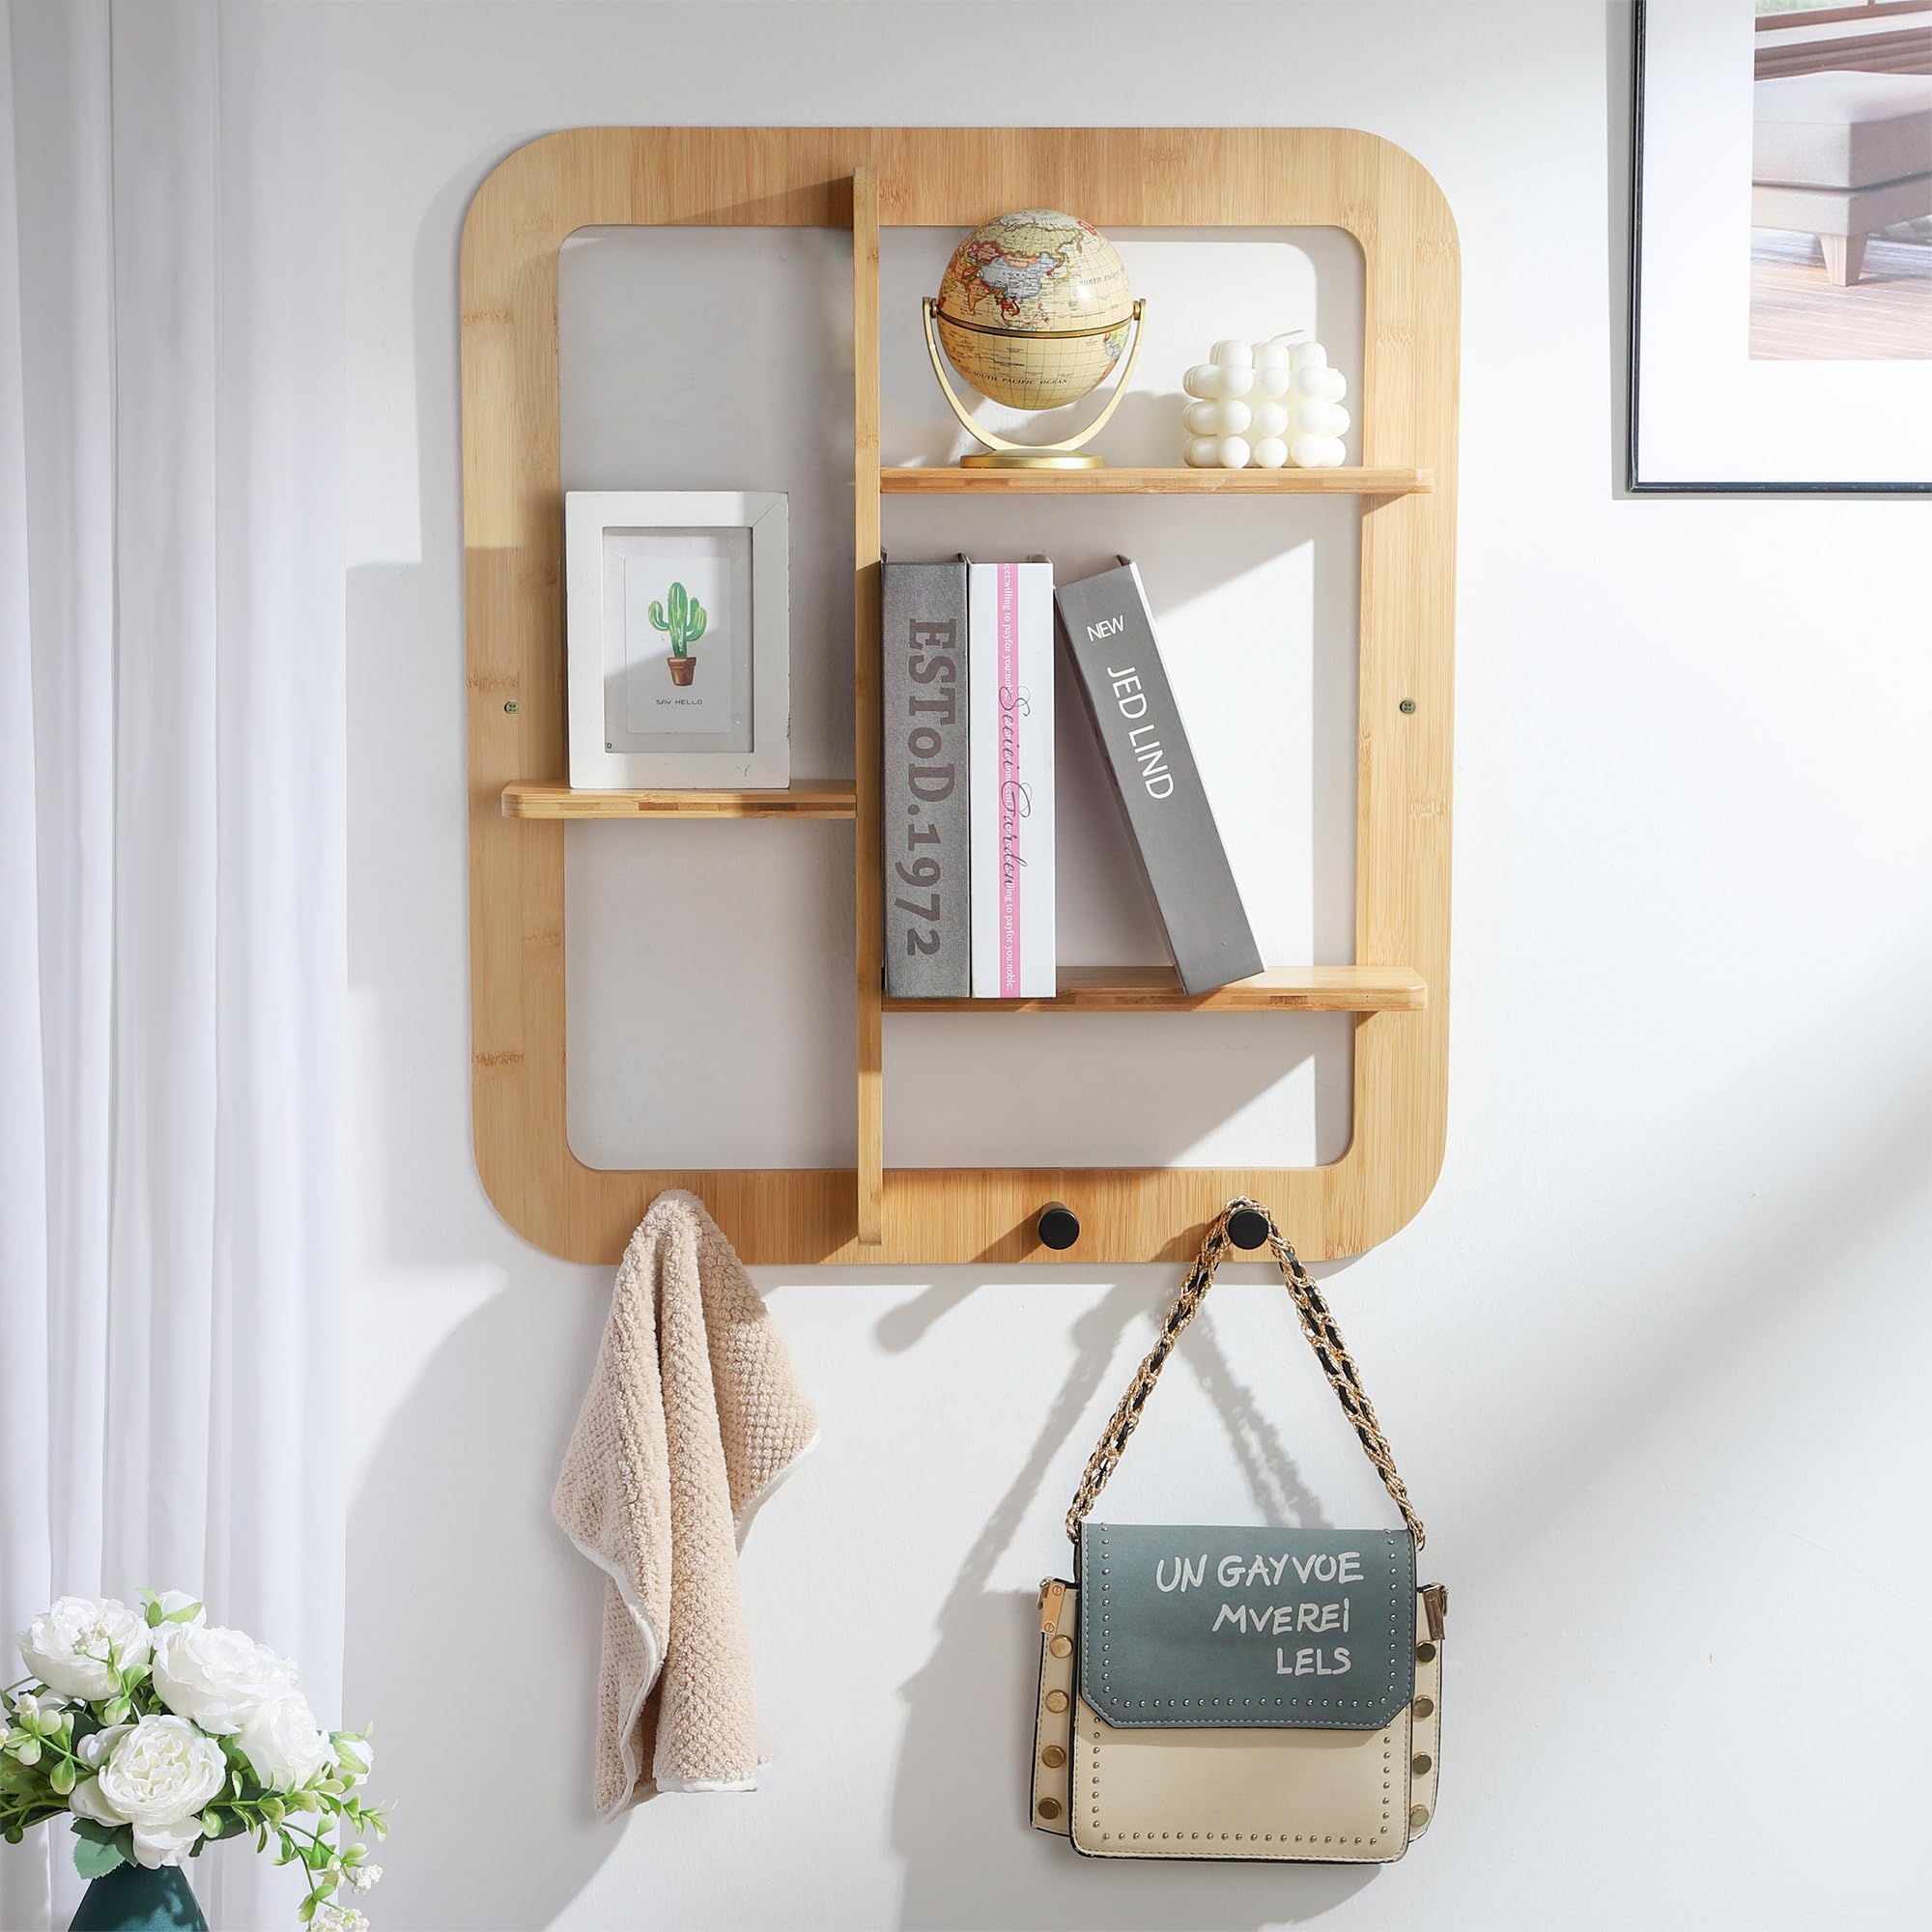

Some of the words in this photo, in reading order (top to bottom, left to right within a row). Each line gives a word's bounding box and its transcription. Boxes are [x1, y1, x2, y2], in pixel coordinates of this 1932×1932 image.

[1004, 612, 1011, 622] to
[1087, 614, 1124, 641] NEW
[1107, 667, 1148, 719] JED
[1128, 724, 1174, 799] LIND
[1006, 904, 1013, 913] to
[1156, 1553, 1208, 1593] UN
[1275, 1647, 1351, 1677] LELS
